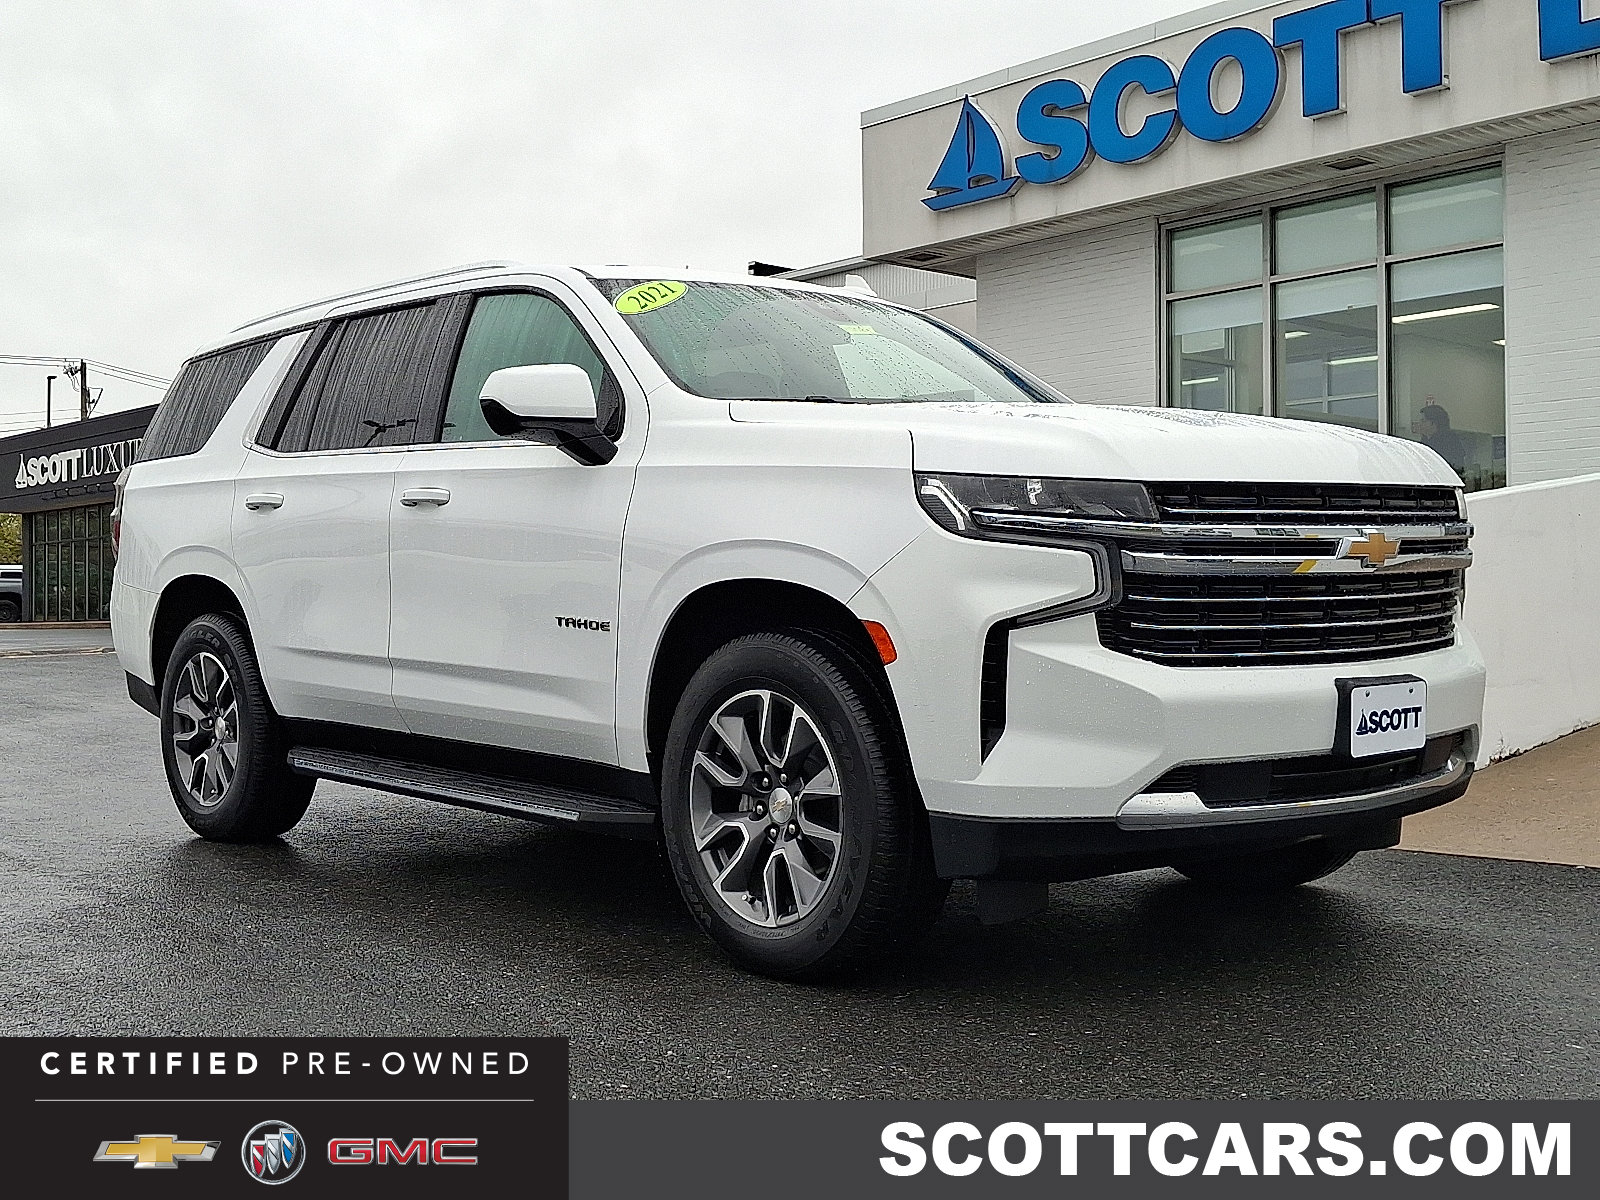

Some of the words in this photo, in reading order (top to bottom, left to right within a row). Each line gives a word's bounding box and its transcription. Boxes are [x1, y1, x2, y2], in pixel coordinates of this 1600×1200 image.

[1014, 0, 1444, 185] SCOTT
[627, 282, 677, 309] 2021
[26, 449, 82, 488] SCOTT
[554, 616, 611, 632] TAHOE
[1368, 705, 1423, 734] SCOTT
